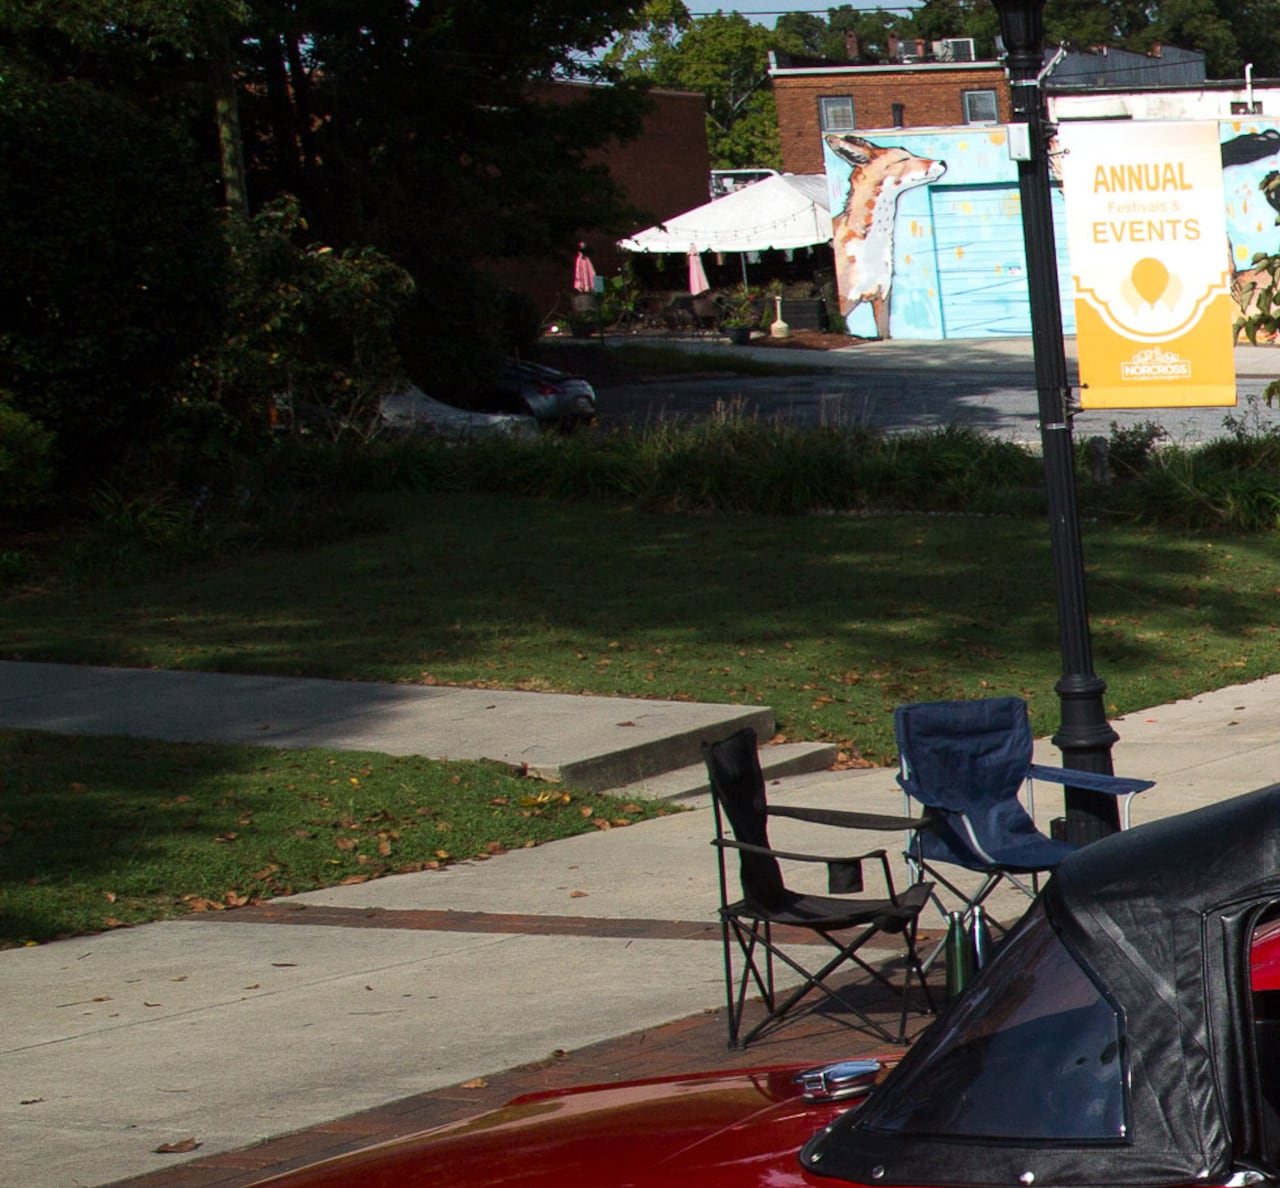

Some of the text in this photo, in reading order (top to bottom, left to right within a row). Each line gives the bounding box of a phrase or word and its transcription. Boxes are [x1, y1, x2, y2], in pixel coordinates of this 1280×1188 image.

[1093, 162, 1193, 193] ANNUAL
[1107, 199, 1181, 213] Festivals &
[1092, 218, 1201, 244] EVENTS
[1124, 364, 1188, 376] NORCROSS
